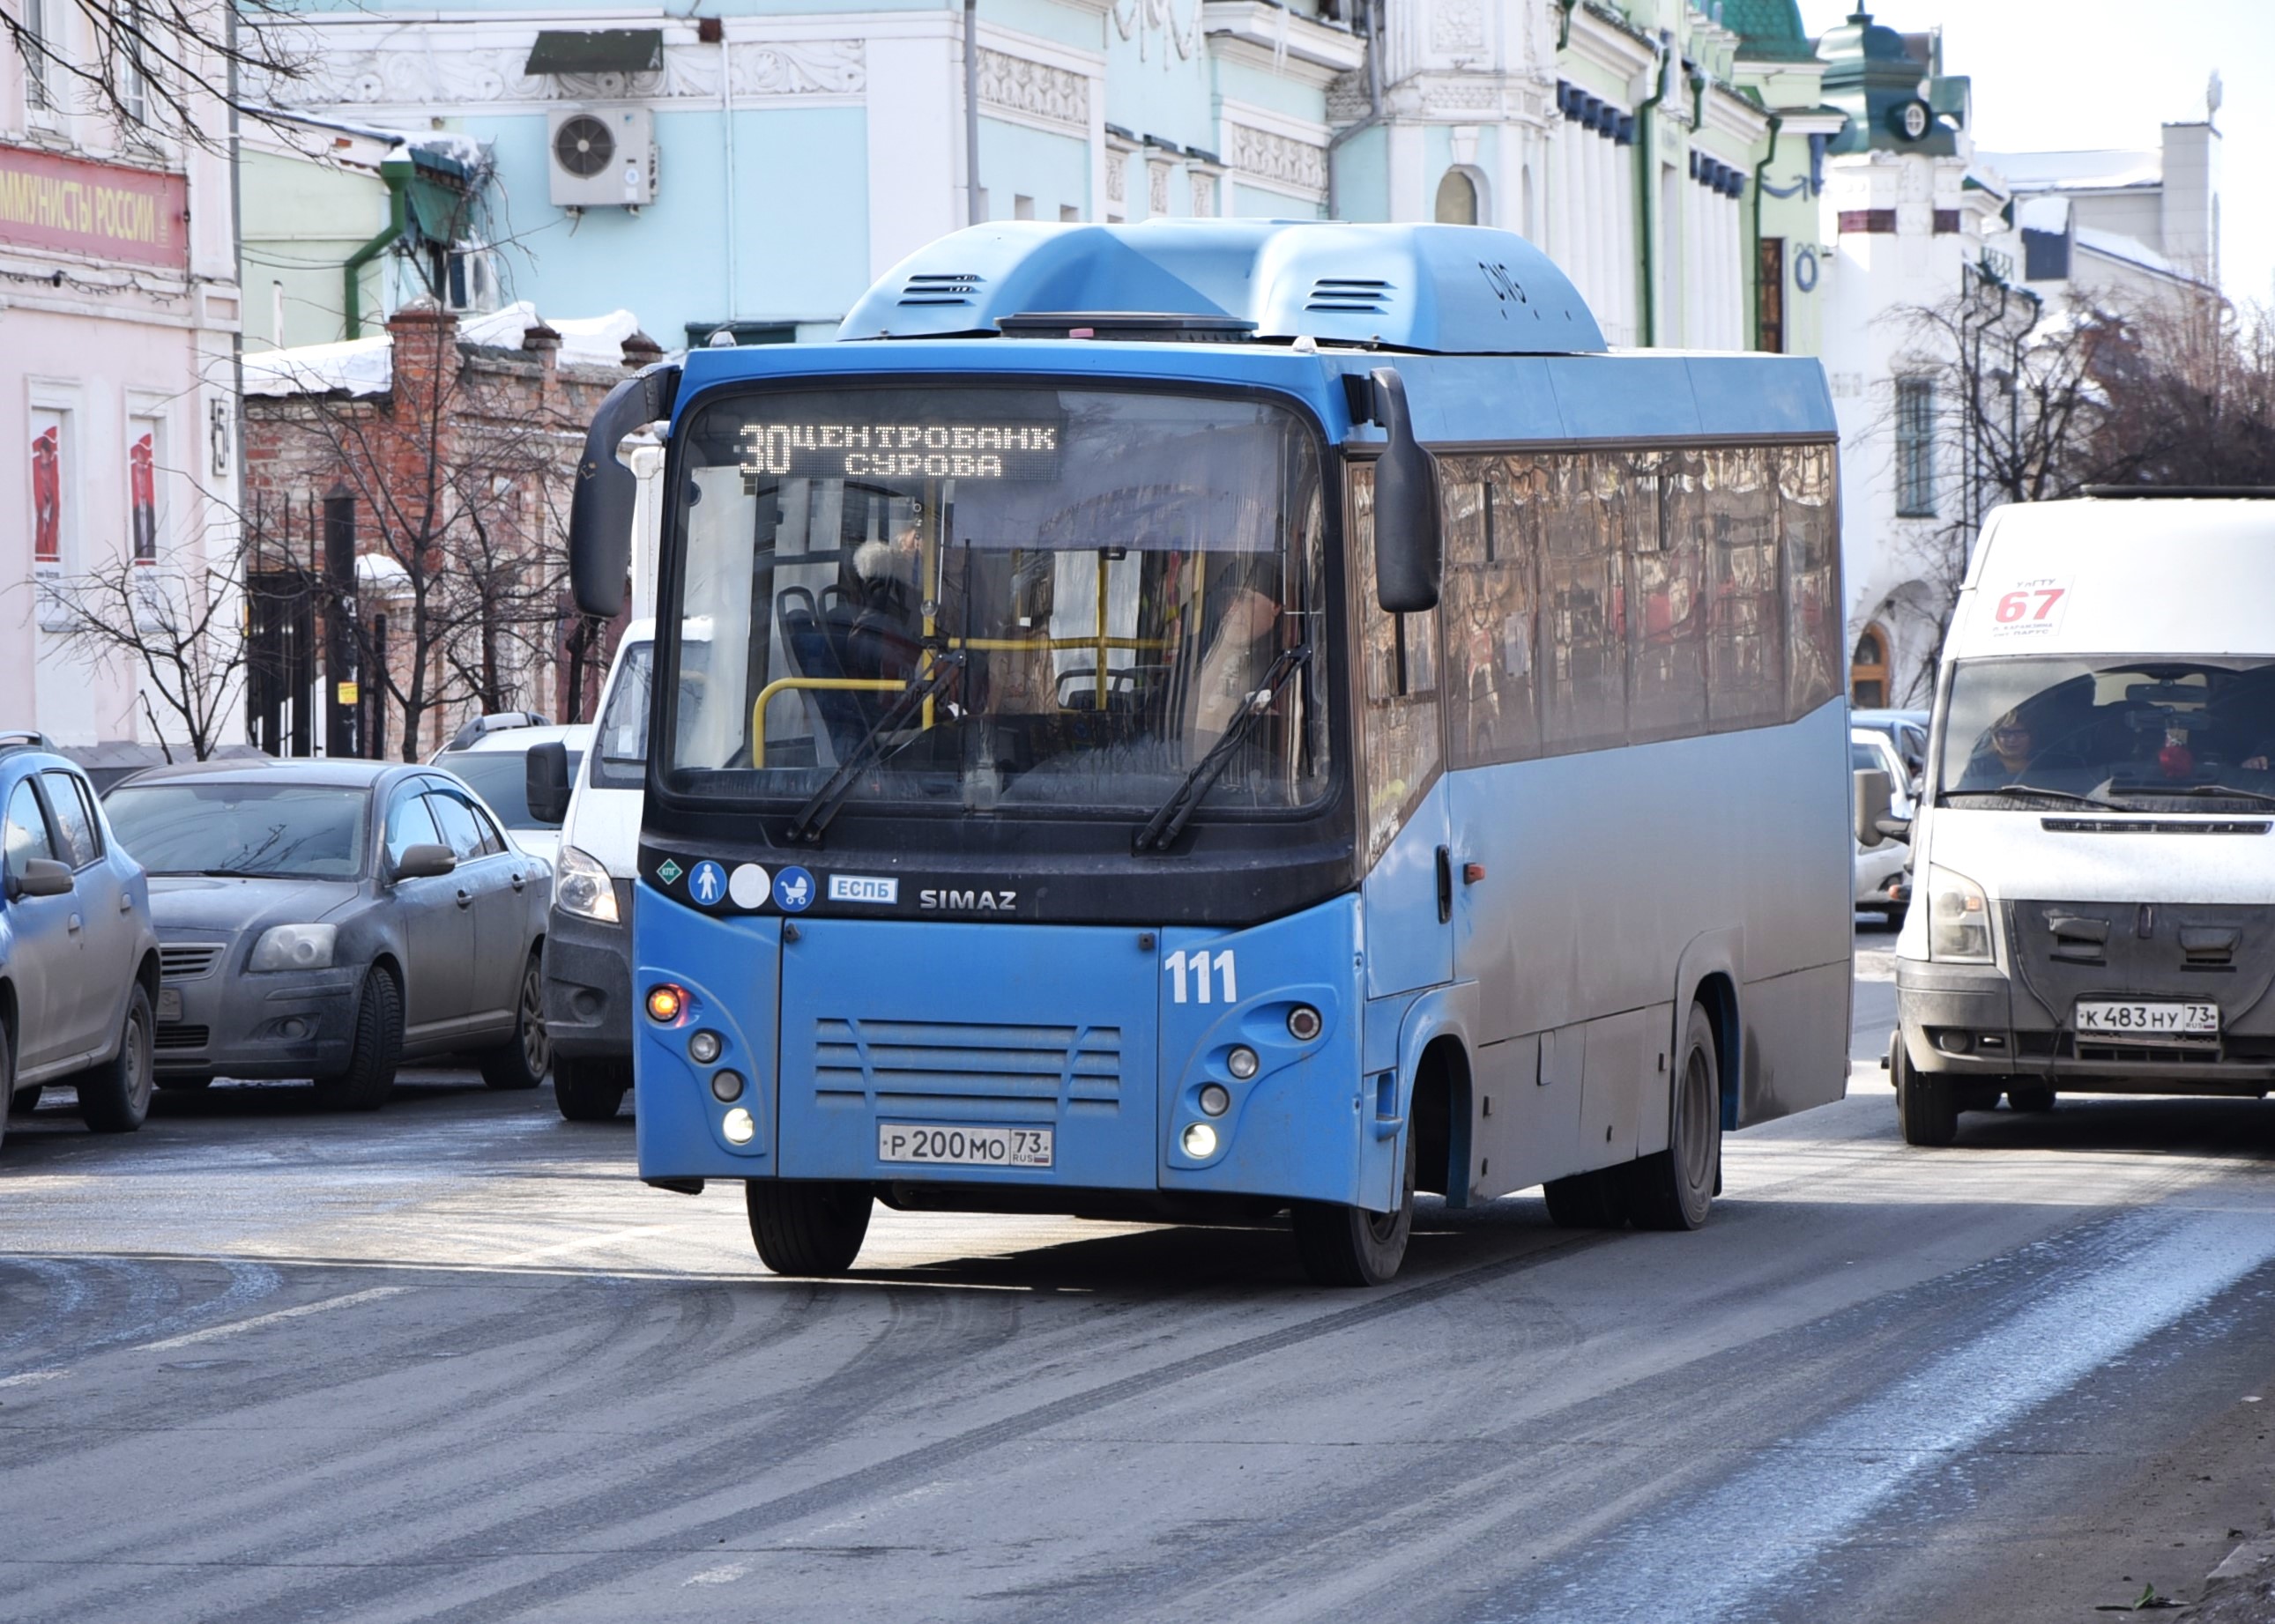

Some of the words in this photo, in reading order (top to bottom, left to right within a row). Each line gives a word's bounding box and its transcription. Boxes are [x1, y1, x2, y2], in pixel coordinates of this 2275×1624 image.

[95, 186, 155, 243] РОССИИ
[740, 424, 791, 474] 30
[792, 425, 1055, 451] ЦЕНТРОБАНК
[844, 454, 1001, 477] СУРОВА
[1995, 588, 2066, 623] 67
[836, 880, 889, 898] ЕСПБ
[919, 889, 1017, 910] SIMAZ
[1164, 949, 1237, 1004] 111
[2187, 1006, 2210, 1022] 73
[1015, 1132, 1042, 1153] 73
[1013, 1153, 1033, 1162] RUS
